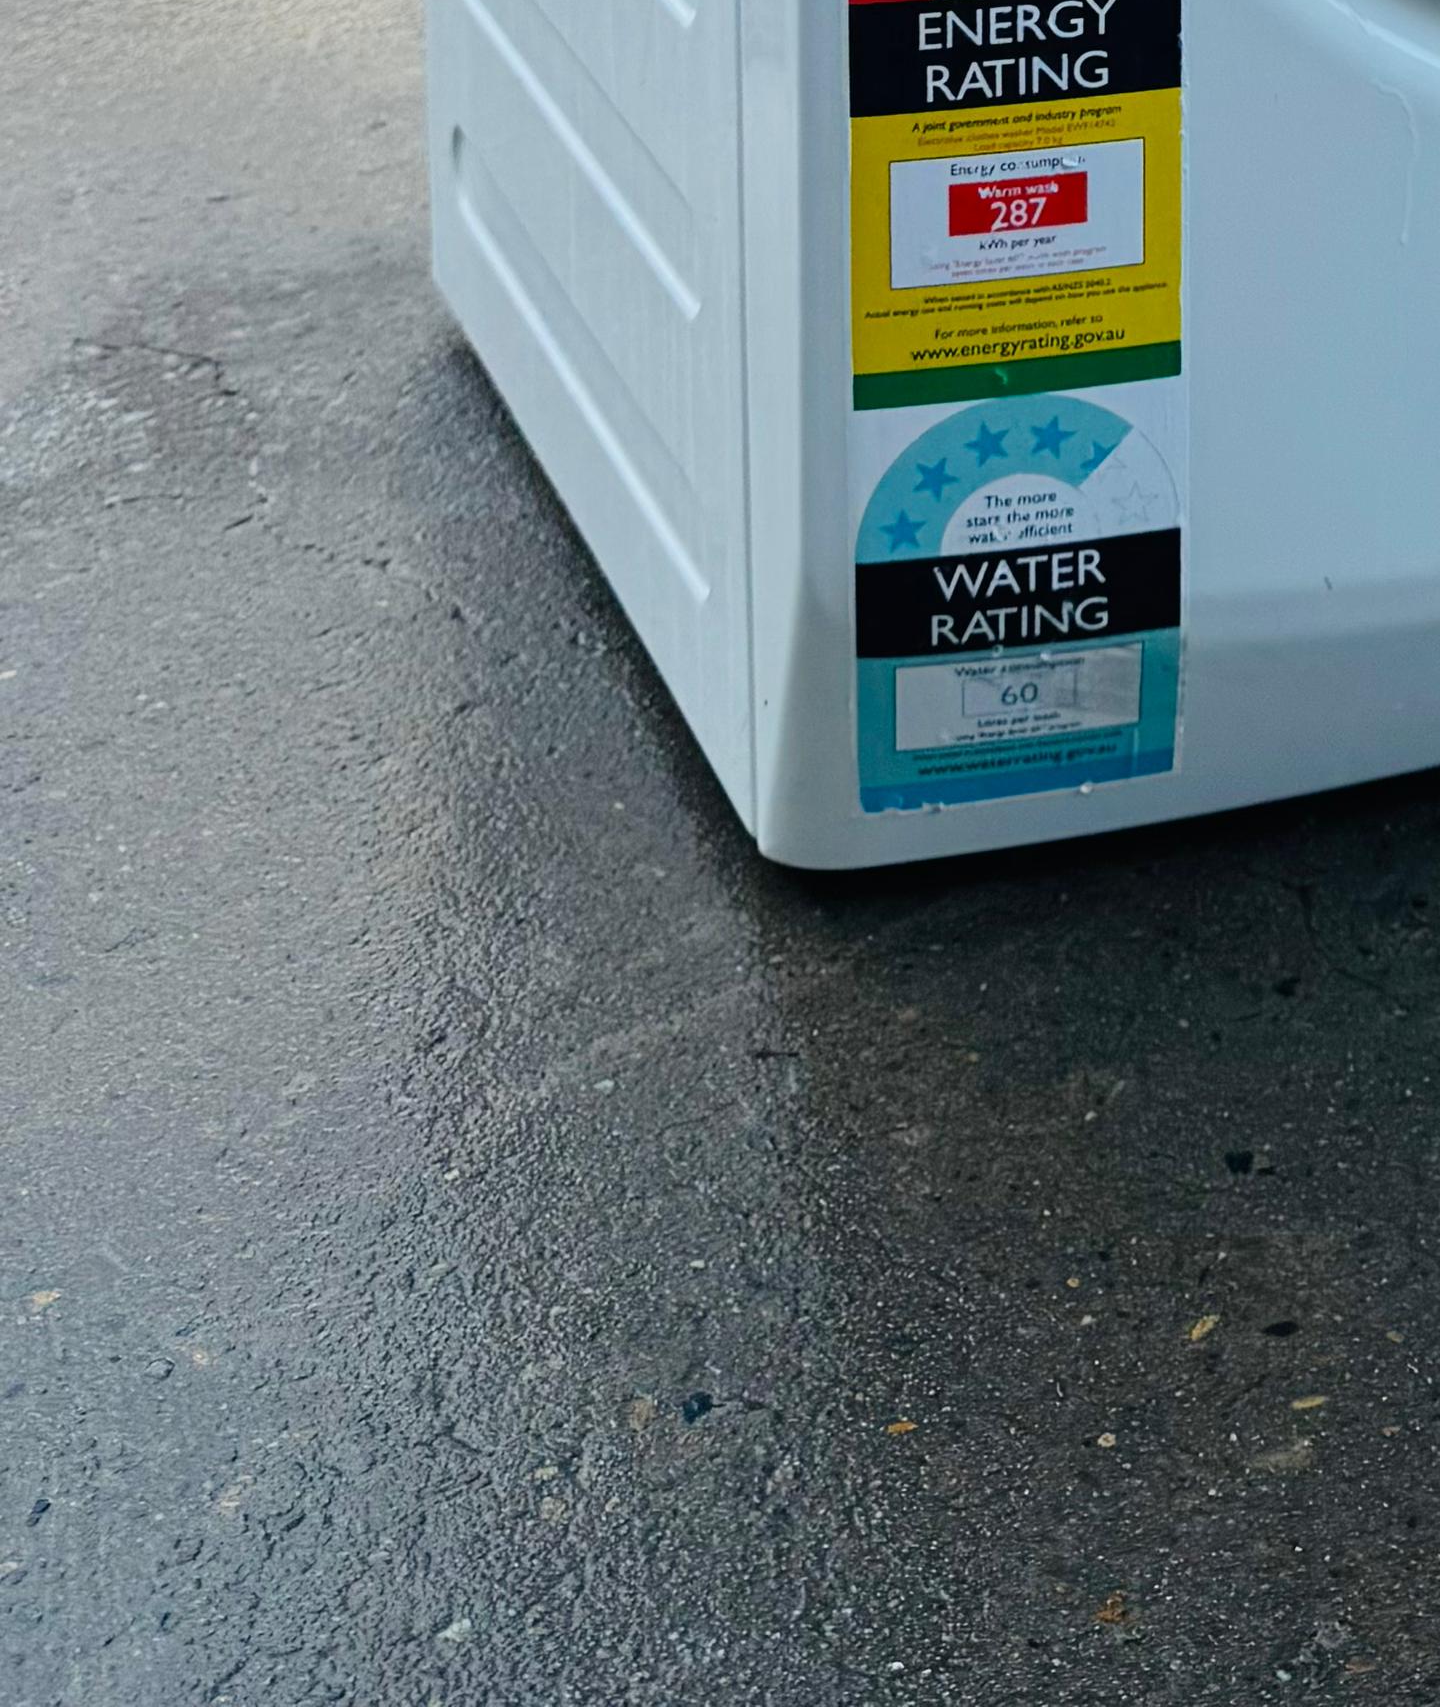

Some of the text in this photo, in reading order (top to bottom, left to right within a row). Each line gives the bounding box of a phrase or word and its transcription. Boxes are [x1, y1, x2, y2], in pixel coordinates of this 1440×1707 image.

[926, 50, 1109, 103] RATING
[912, 105, 1122, 134] A joint government and industry program
[950, 164, 995, 177] Energy
[978, 181, 1060, 199] Warm wash
[990, 197, 1047, 233] 287
[979, 234, 1056, 251] kWh per year
[934, 314, 1104, 341] For more information, refer to
[911, 329, 1126, 362] www.energyrating.gov.au
[984, 491, 1058, 509] The more
[966, 506, 1075, 528] stars the more
[933, 549, 1107, 603] WATER
[931, 596, 1109, 647] RATING
[1001, 682, 1039, 706] 60
